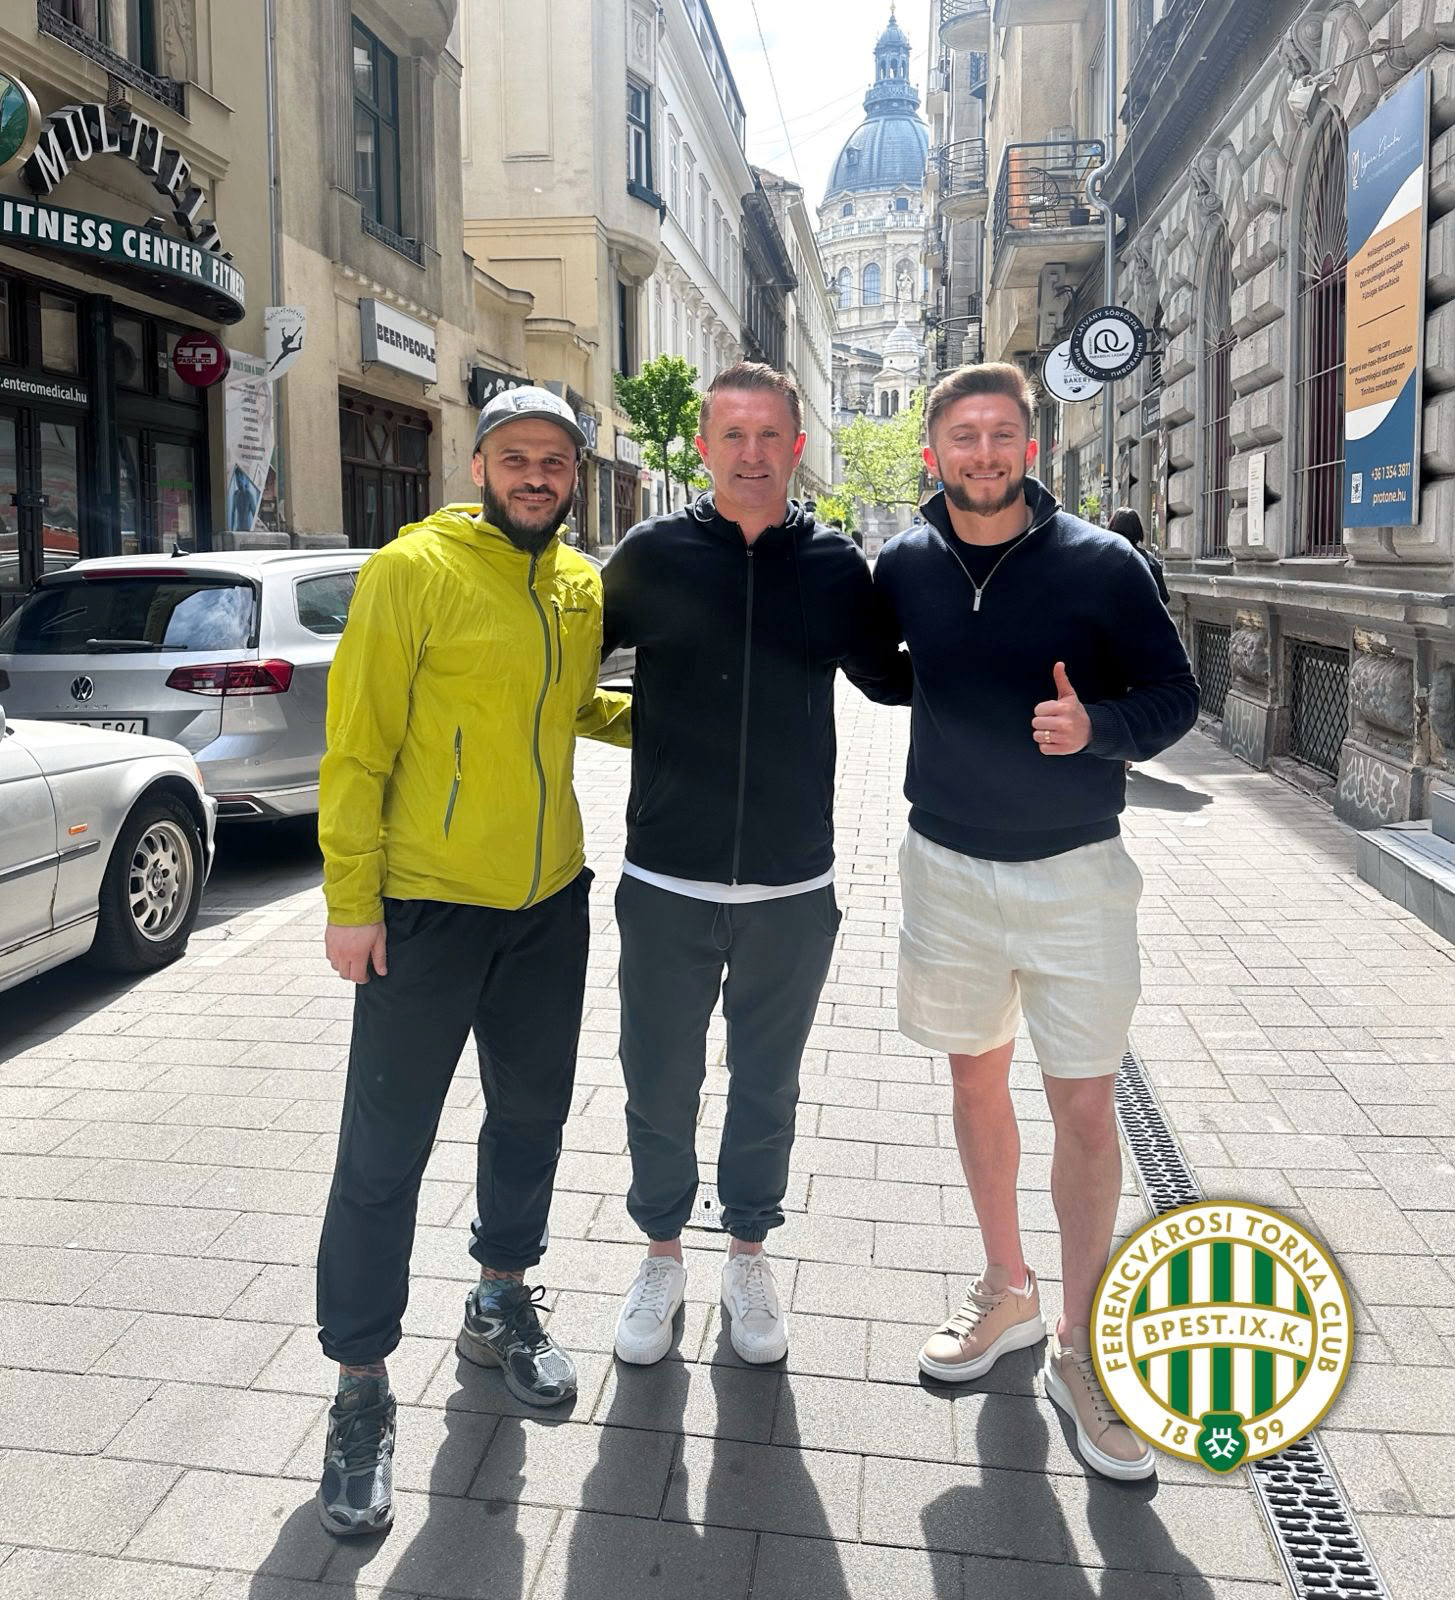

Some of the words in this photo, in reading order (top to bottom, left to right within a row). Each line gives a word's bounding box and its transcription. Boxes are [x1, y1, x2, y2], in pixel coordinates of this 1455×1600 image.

[3, 200, 113, 252] ITNESS
[122, 229, 203, 278] CENTER
[376, 322, 403, 350] BEER
[402, 334, 436, 364] PEOPLE
[1074, 348, 1099, 376] BREWERY
[0, 376, 87, 403] .enteromedical.hu
[1371, 466, 1381, 480] +36
[1385, 464, 1397, 479] 354
[1372, 488, 1407, 507] protone.hu
